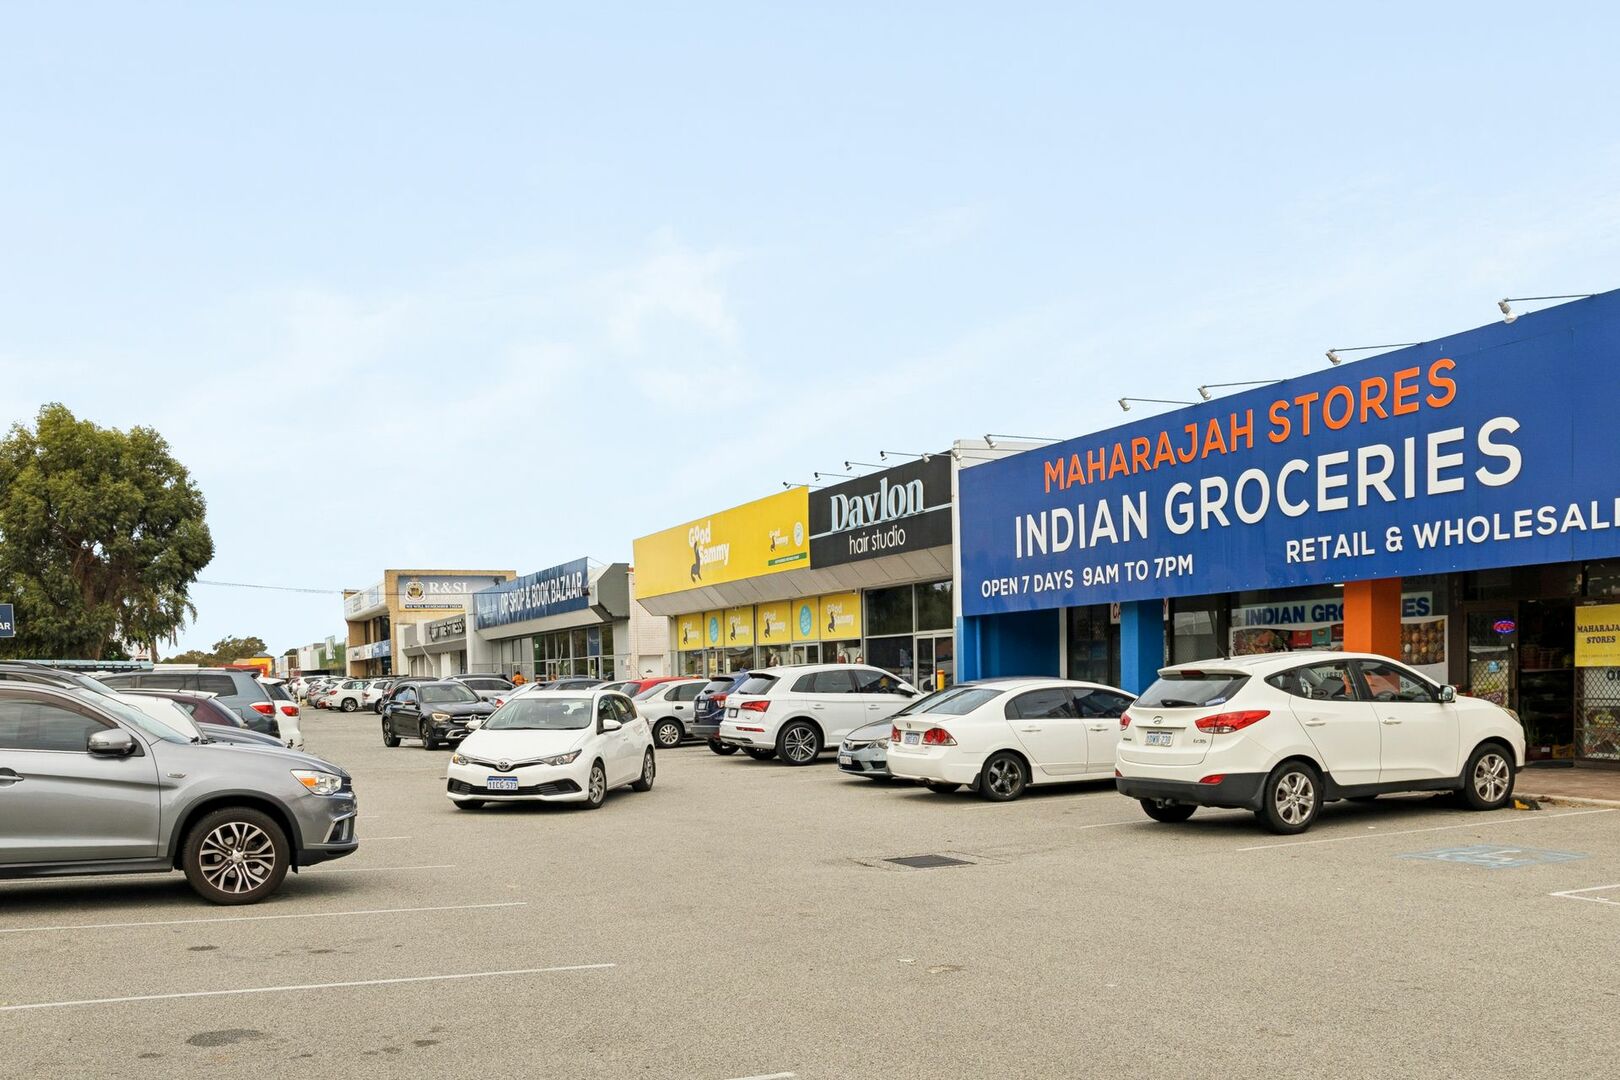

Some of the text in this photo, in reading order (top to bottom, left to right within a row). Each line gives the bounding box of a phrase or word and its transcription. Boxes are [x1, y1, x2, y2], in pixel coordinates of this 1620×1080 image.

[1045, 359, 1456, 488] MAHARAJAH STORES
[830, 477, 924, 533] Davlon
[1015, 416, 1523, 560] INDIAN GROCERIES
[688, 520, 711, 548] Good
[849, 524, 905, 555] hair studio
[1285, 530, 1377, 565] RETAIL
[1385, 525, 1405, 552] &
[699, 543, 730, 566] Sammy
[509, 588, 525, 613] SHOP
[531, 580, 550, 608] BOOK
[550, 571, 583, 604] BAZAAR
[981, 553, 1194, 598] OPEN 7 DAYS 9AM TO 7PM
[1245, 605, 1306, 626] INDIAN
[1586, 635, 1616, 644] STORES
